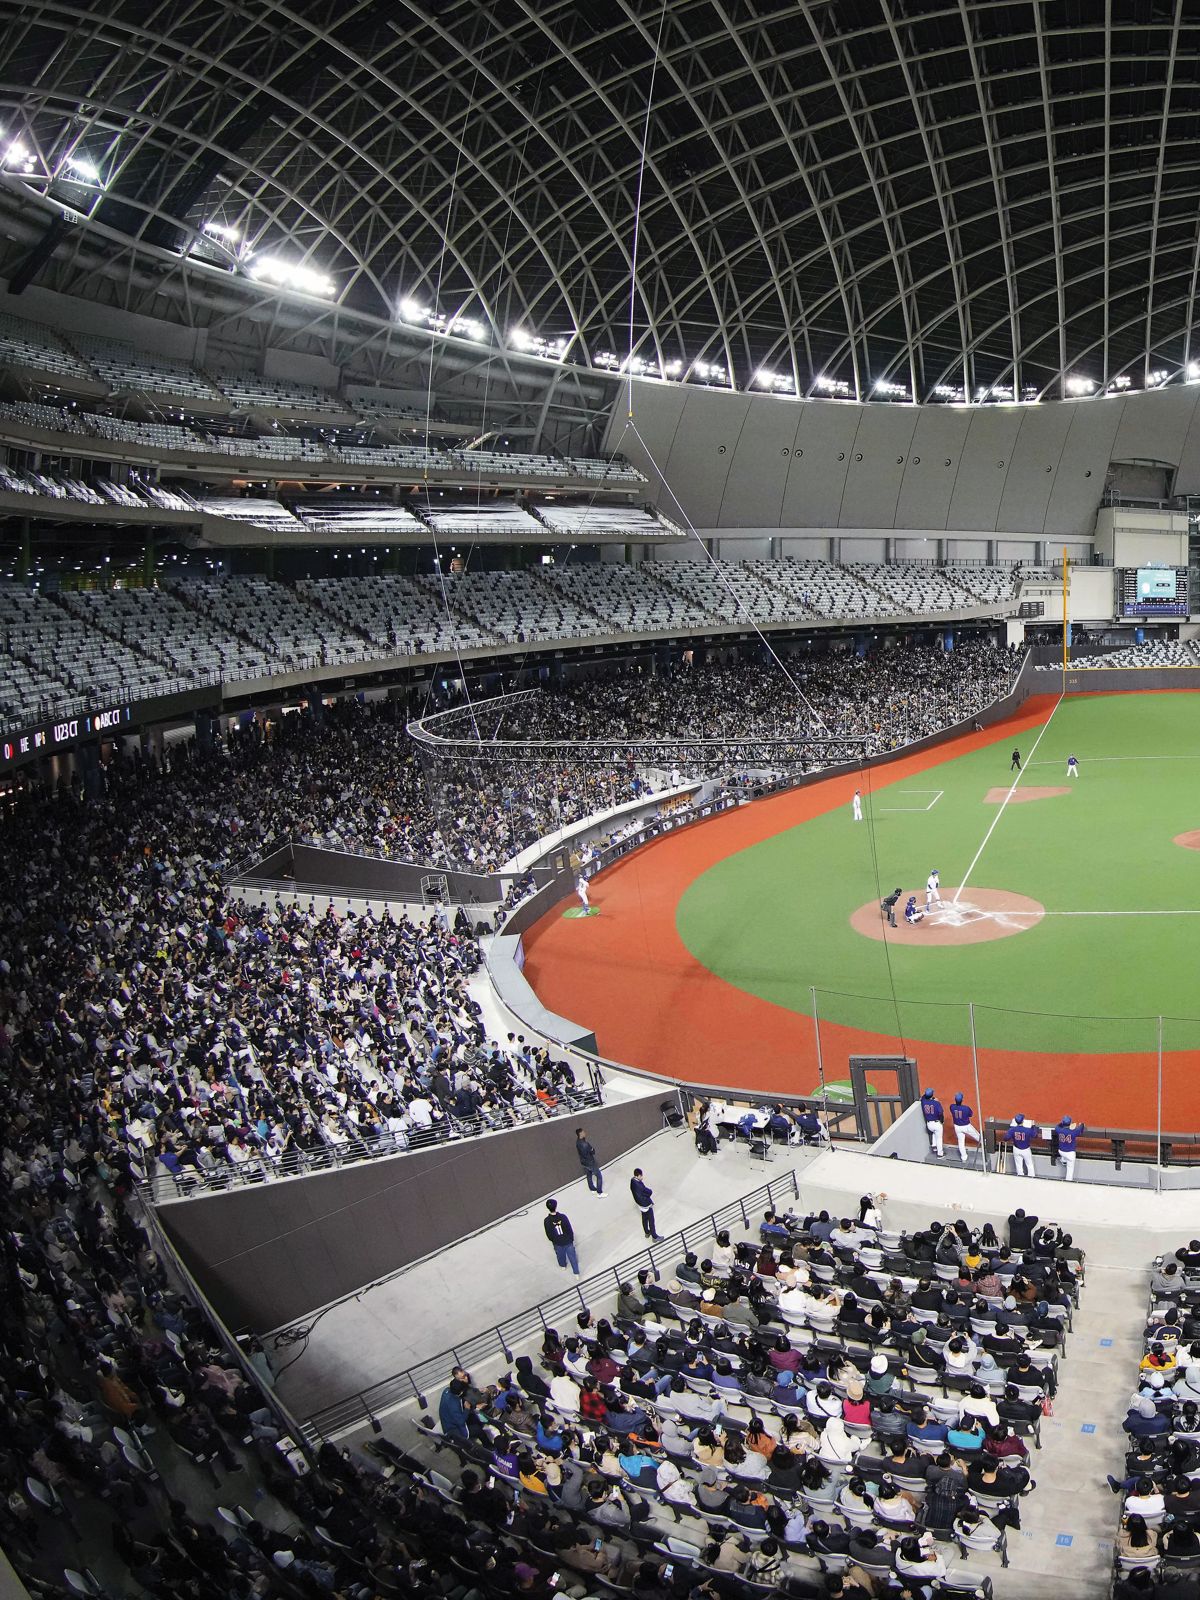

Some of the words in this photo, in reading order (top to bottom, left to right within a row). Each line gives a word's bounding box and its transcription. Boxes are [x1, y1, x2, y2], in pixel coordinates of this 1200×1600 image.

[54, 723, 68, 742] U23
[69, 721, 78, 737] CT
[86, 718, 90, 732] 1
[100, 711, 112, 728] ABC
[113, 710, 120, 725] CT
[126, 707, 130, 720] 1
[1014, 1132, 1025, 1141] 51
[555, 1225, 563, 1235] 11
